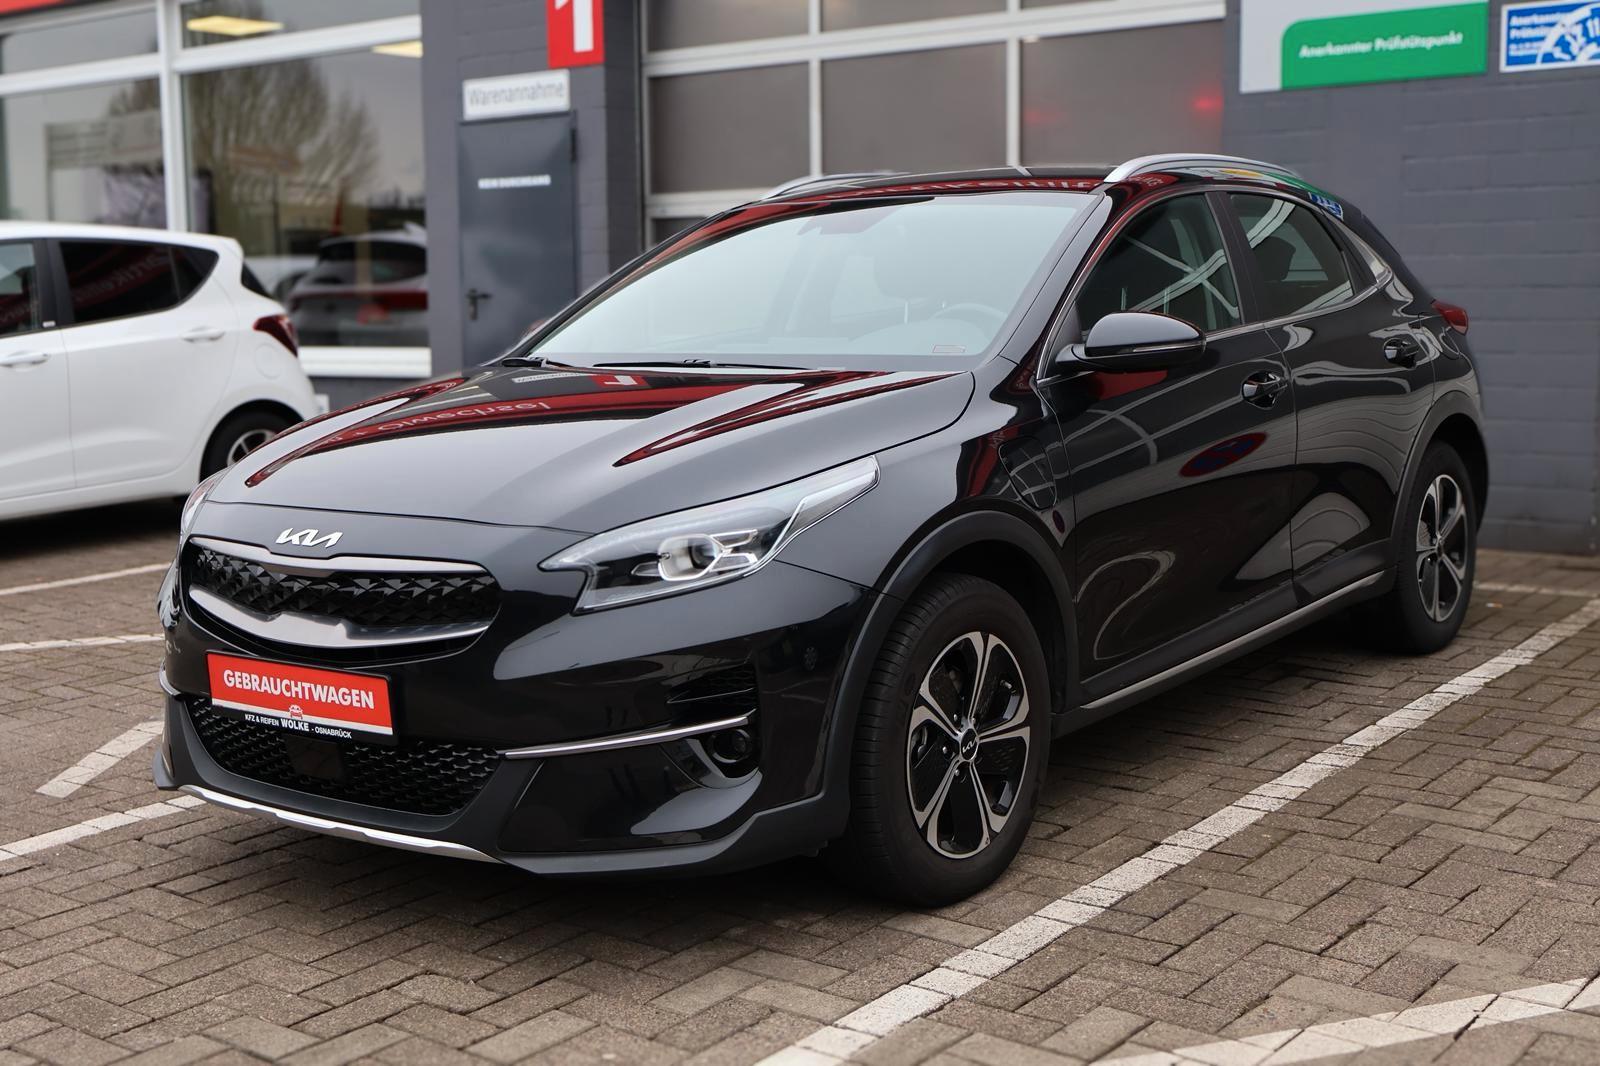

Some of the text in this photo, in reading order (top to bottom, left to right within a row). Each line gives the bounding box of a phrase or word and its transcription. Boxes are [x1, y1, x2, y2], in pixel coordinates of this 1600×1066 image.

[555, 0, 594, 53] 1
[467, 81, 566, 107] Warenannahme
[222, 669, 375, 710] GEBRAUCHTWAGEN
[244, 713, 255, 723] KFZ
[260, 717, 280, 727] REIFEN
[280, 717, 310, 732] WOLKE
[314, 726, 352, 739] OSNABRÜCK
